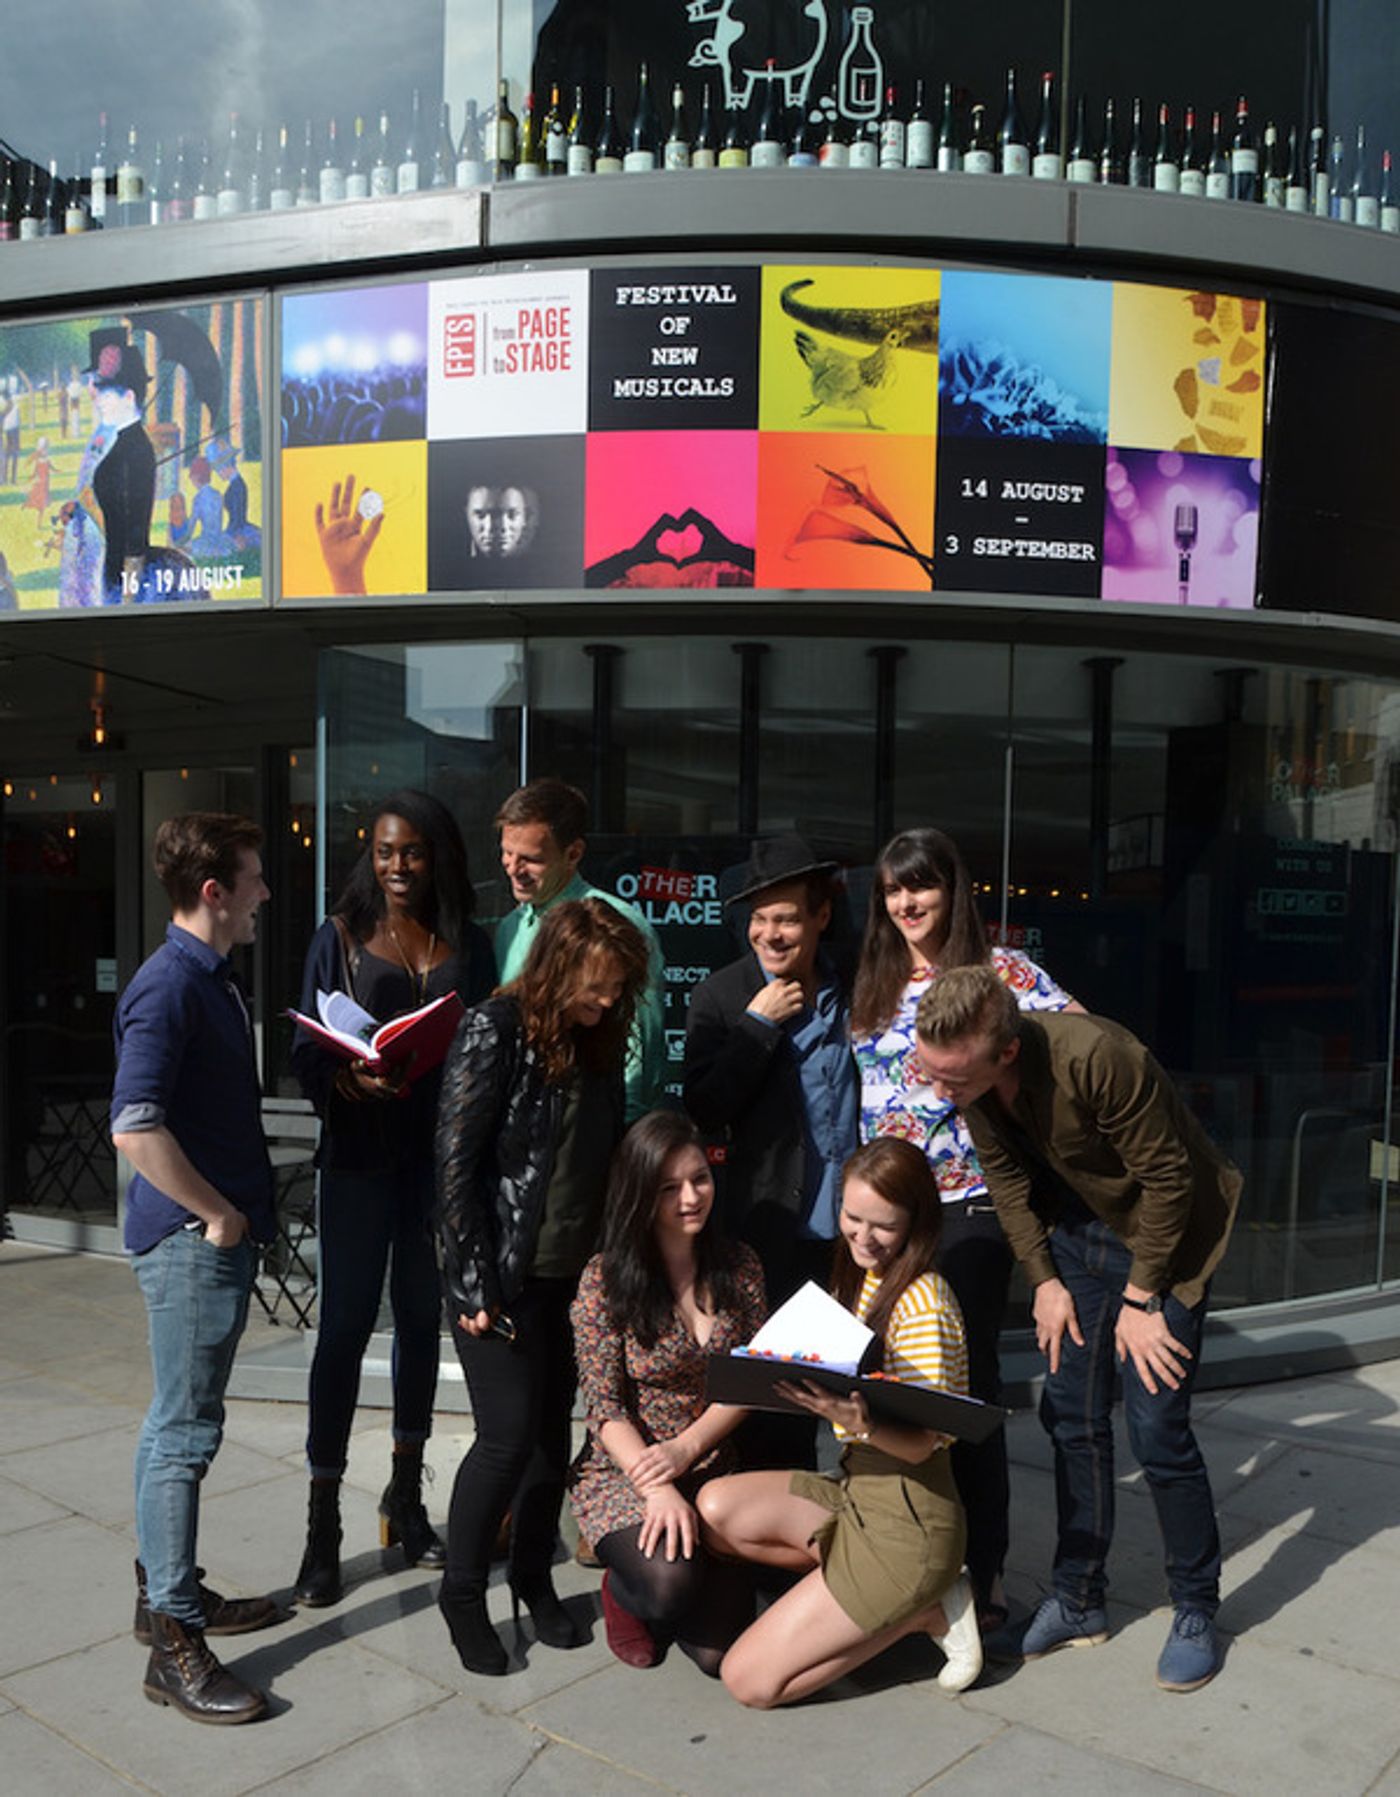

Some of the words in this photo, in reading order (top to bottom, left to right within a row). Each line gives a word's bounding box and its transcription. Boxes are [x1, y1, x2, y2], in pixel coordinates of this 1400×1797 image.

[615, 285, 737, 305] FESTIVAL
[518, 306, 571, 339] PAGE
[659, 316, 690, 335] OF
[445, 315, 475, 377] FPTS
[506, 341, 571, 374] STAGE
[651, 347, 699, 366] NEW
[613, 377, 735, 398] MUSICALS
[961, 478, 988, 498] 14
[1000, 480, 1085, 503] AUGUST
[945, 535, 959, 554] 3
[972, 537, 1096, 561] SEPTEMBER
[121, 571, 139, 594] 16
[156, 569, 173, 593] 19
[179, 565, 244, 592] AUGUST
[616, 869, 718, 899] OTHER
